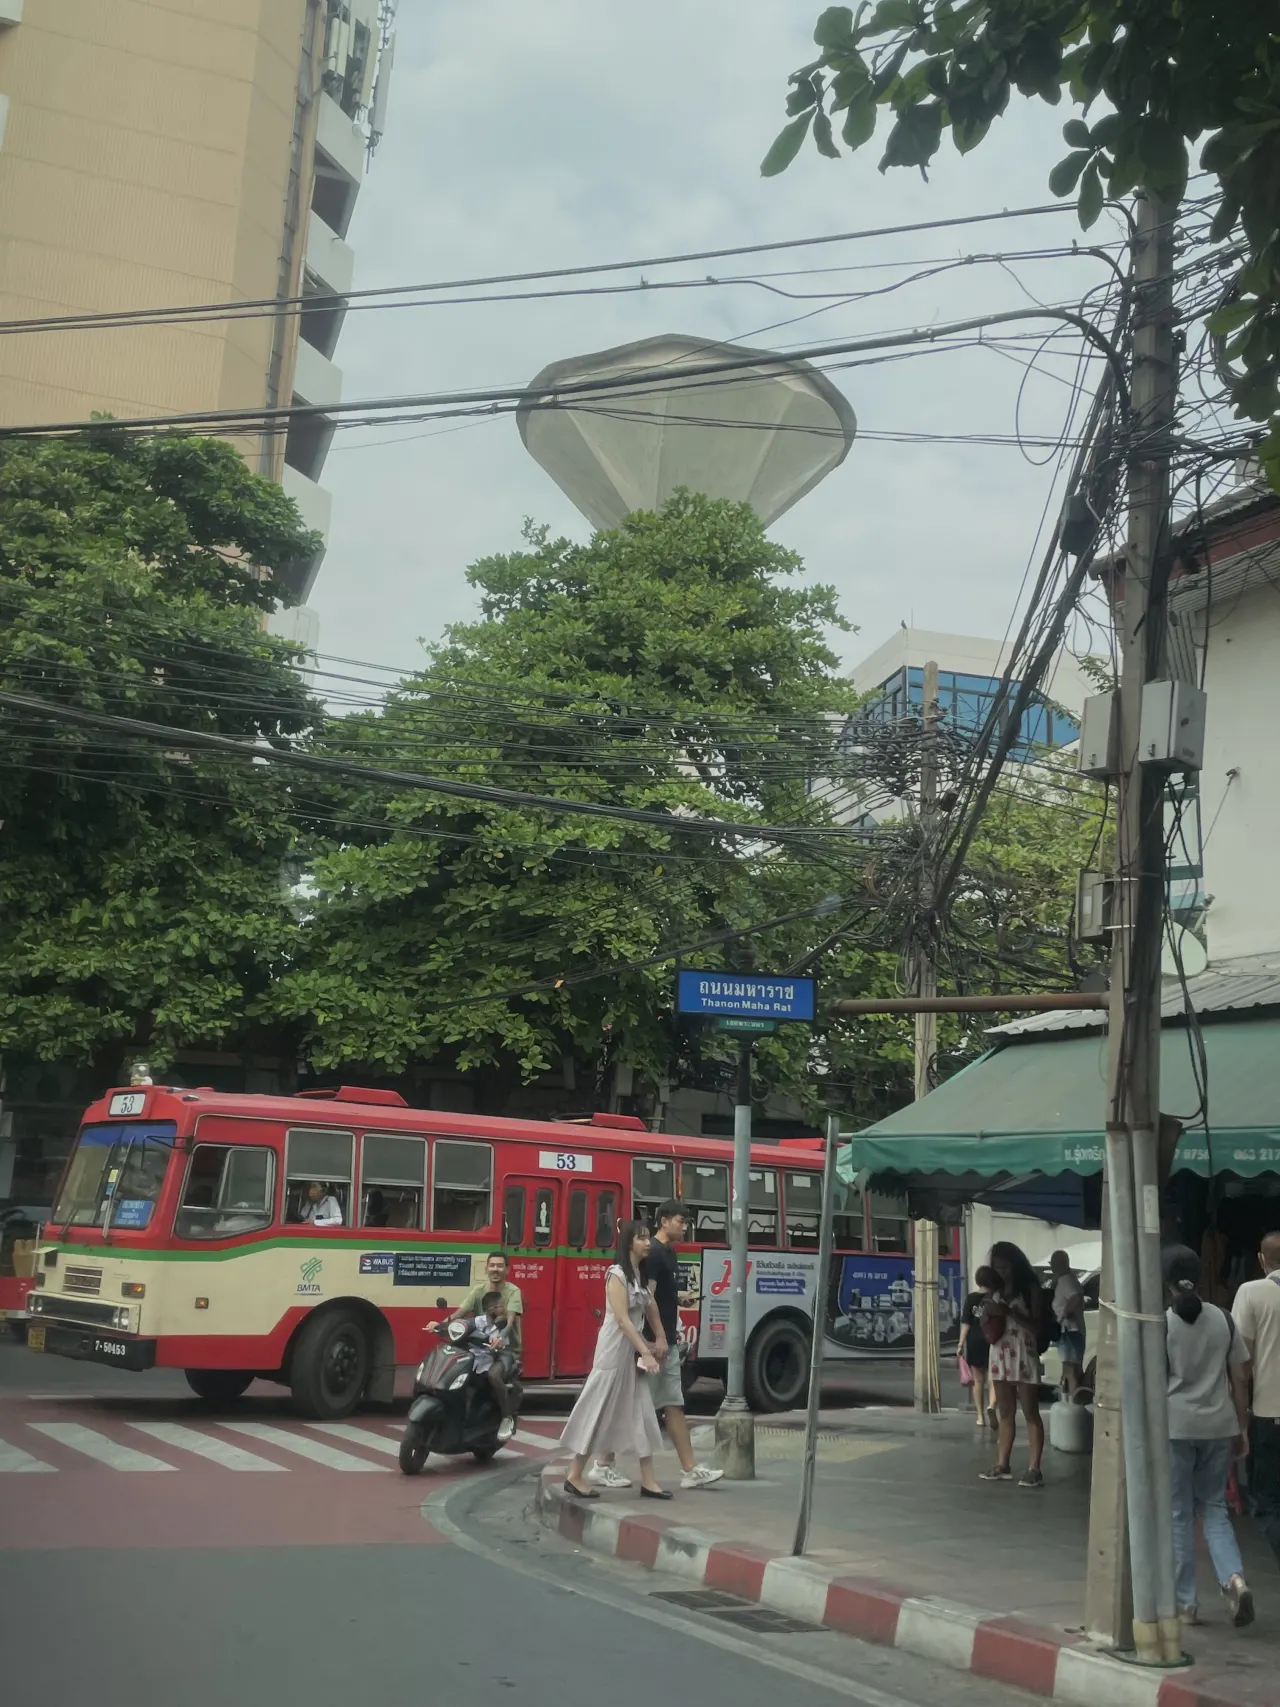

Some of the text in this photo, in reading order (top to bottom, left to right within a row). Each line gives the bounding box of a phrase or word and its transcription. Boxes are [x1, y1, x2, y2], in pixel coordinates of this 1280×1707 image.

[699, 981, 794, 999] ถนนมหาราช
[701, 998, 792, 1012] Thanon Maha Rat
[121, 1095, 135, 1114] 53
[556, 1153, 576, 1170] 53
[296, 1284, 321, 1292] BMTA
